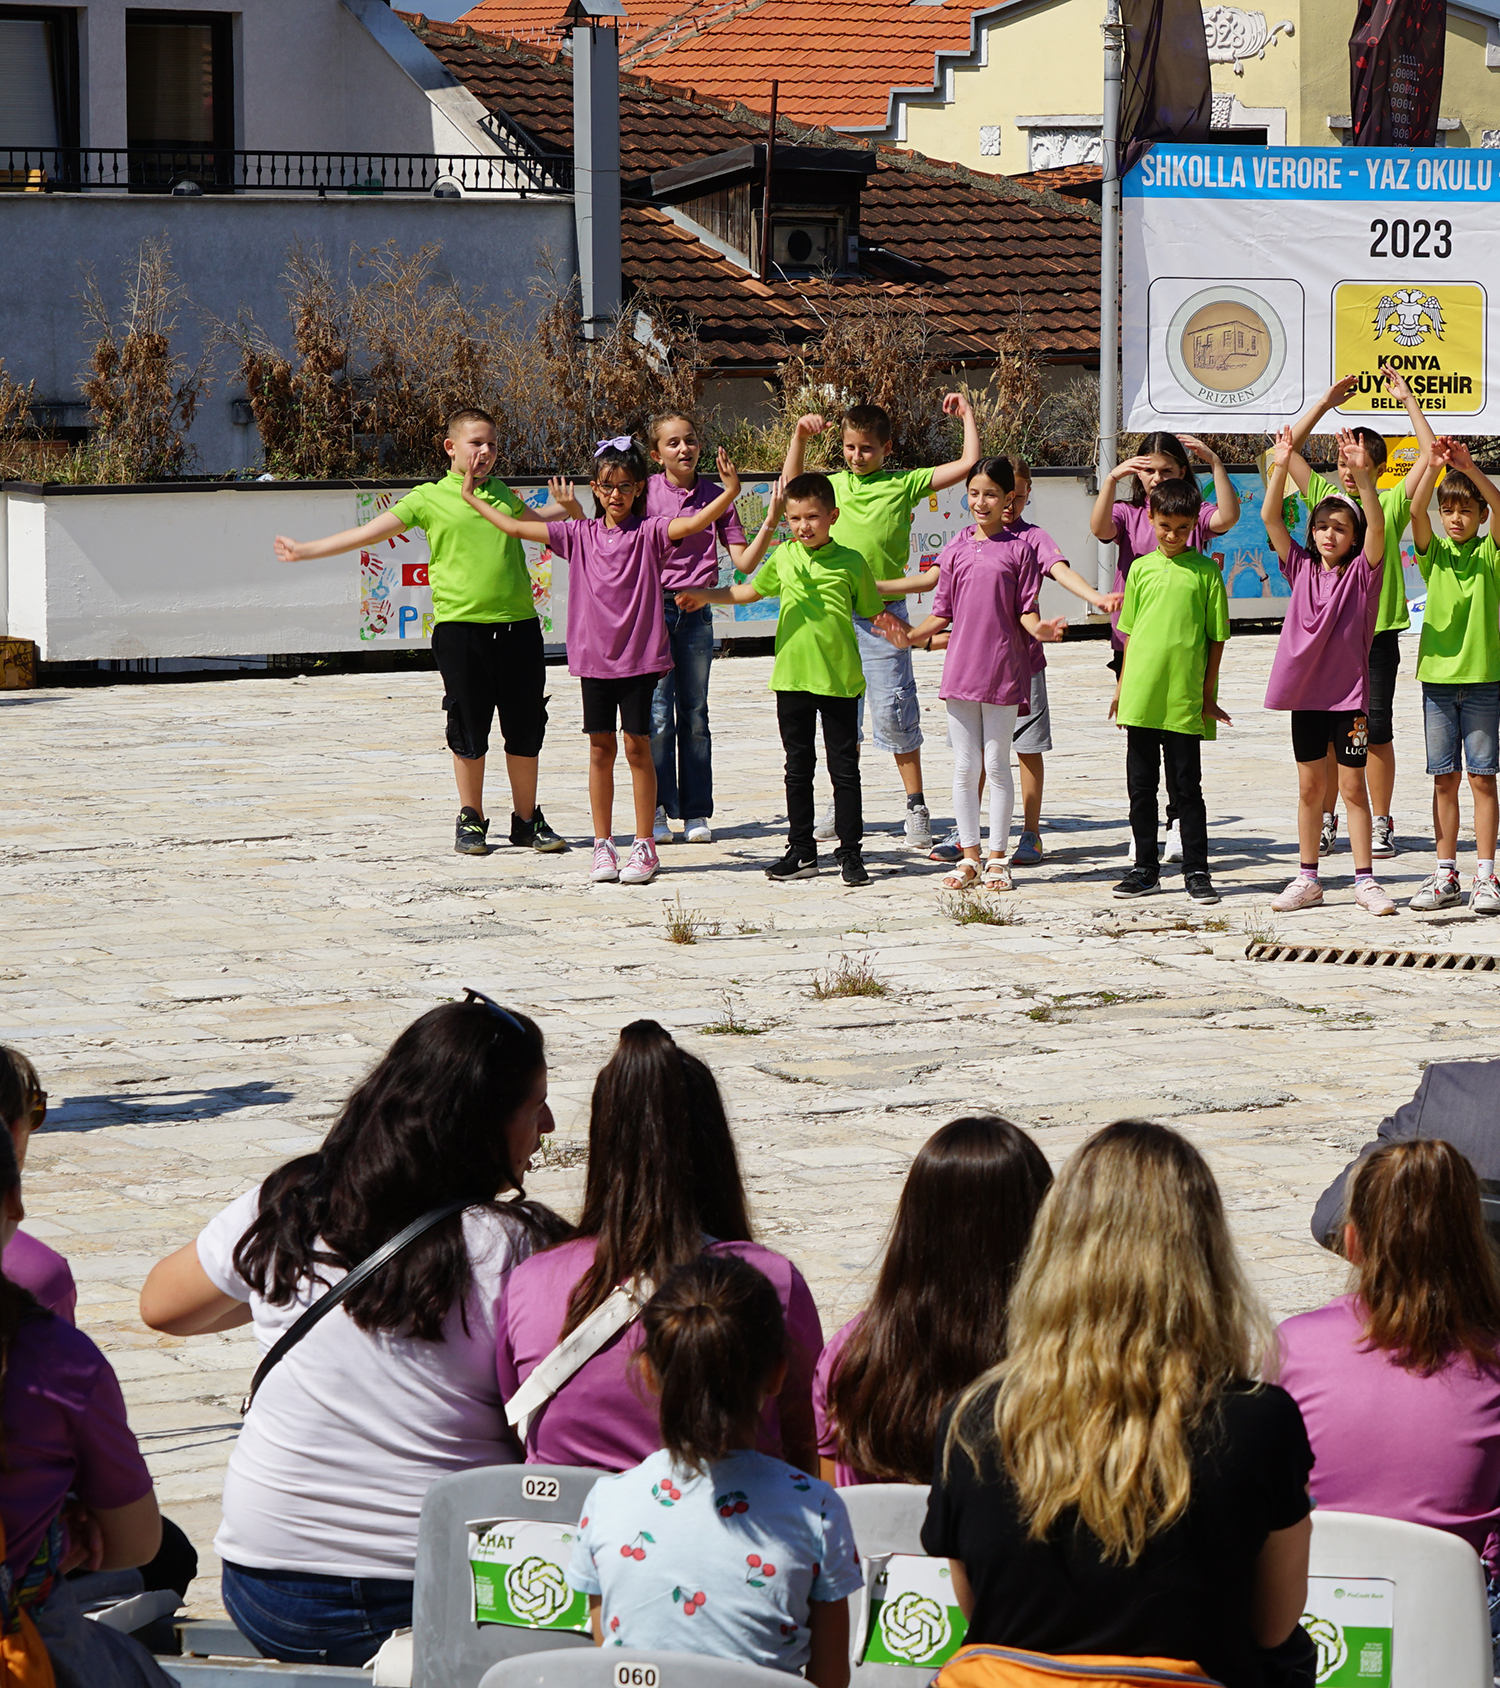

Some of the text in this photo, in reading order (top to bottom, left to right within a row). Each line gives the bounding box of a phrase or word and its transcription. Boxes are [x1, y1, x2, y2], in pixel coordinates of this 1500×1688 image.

[1141, 155, 1246, 188] SHKOLLA
[1253, 157, 1342, 190] VERORE
[1366, 158, 1410, 190] YAZ
[1416, 159, 1492, 191] OKULU
[1370, 218, 1452, 259] 2023
[1377, 355, 1441, 371] KONYA
[1345, 371, 1472, 396] ÜYKŞEHİR
[1197, 386, 1256, 405] PRIZREN
[1371, 396, 1446, 409] BELEYESİ
[399, 605, 435, 639] PR
[525, 1479, 557, 1498] 022
[478, 1533, 515, 1550] CHAT
[618, 1666, 656, 1687] 060
